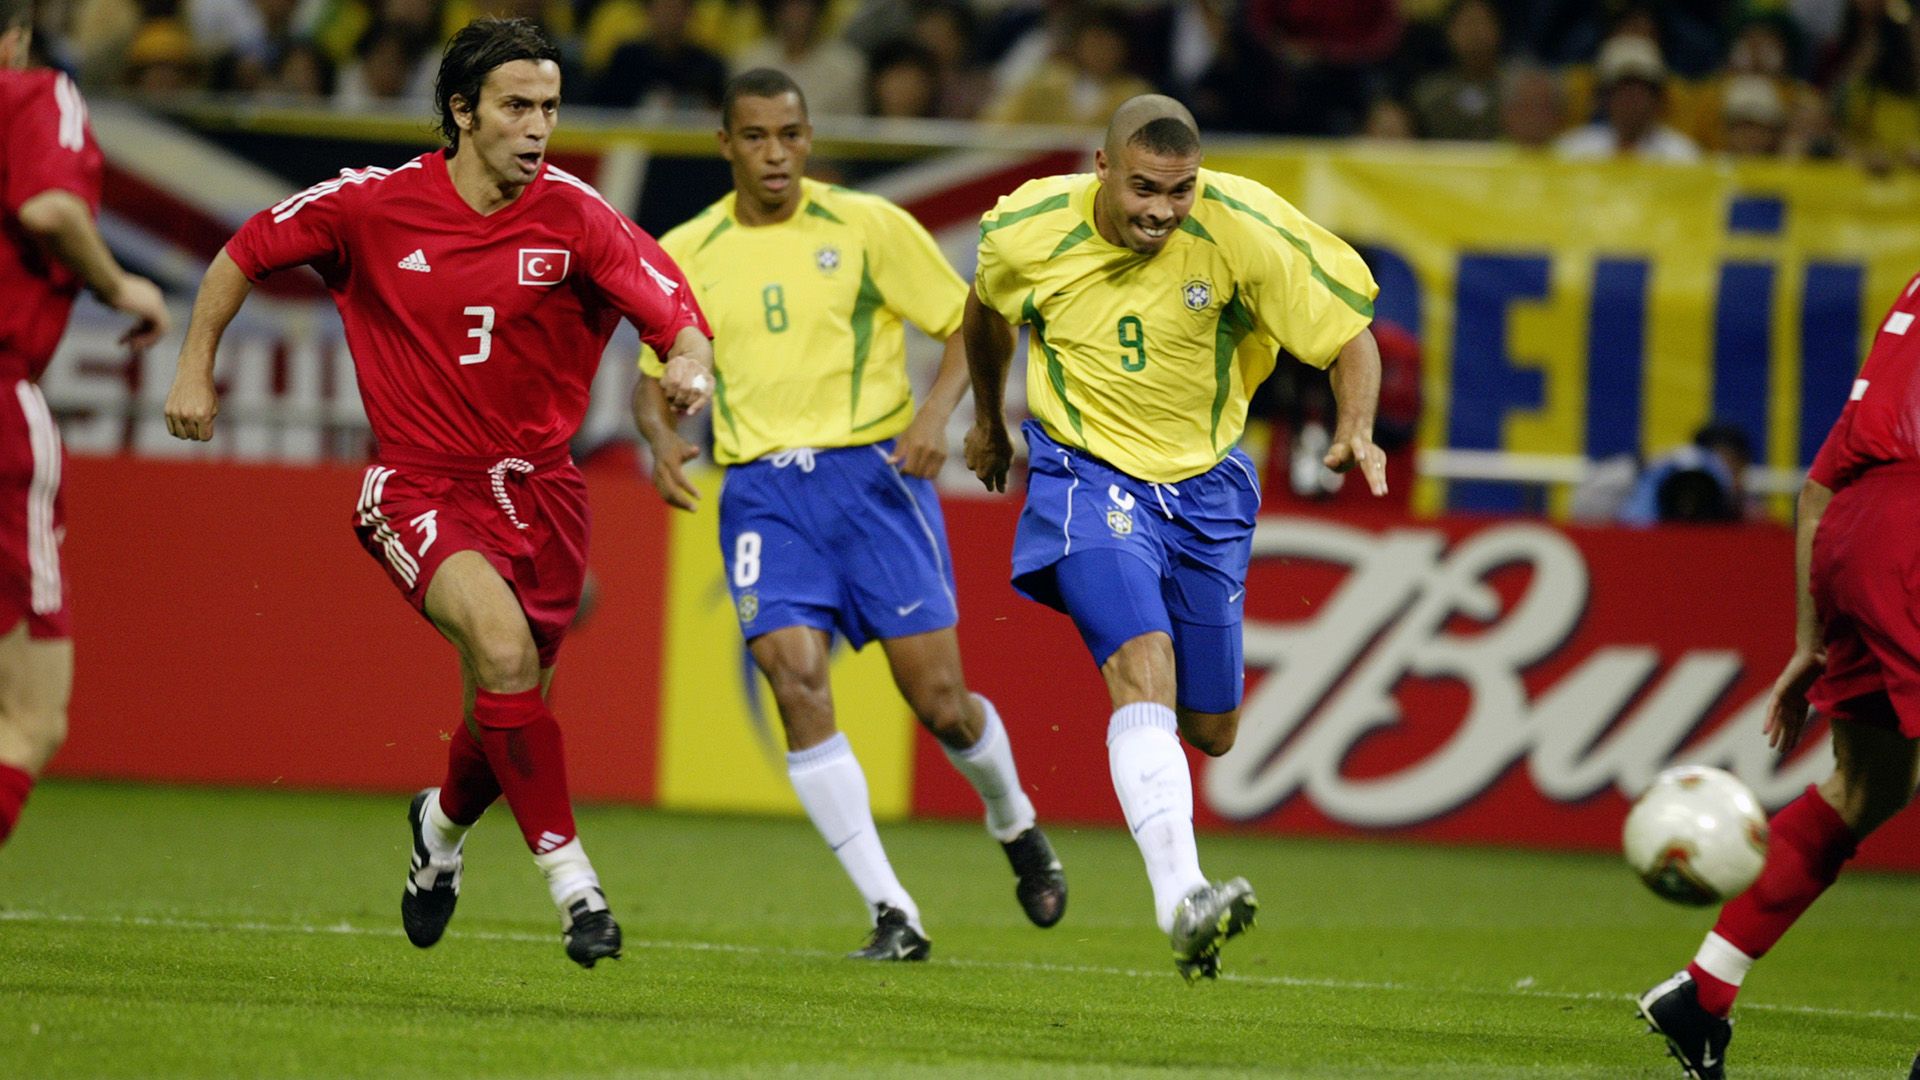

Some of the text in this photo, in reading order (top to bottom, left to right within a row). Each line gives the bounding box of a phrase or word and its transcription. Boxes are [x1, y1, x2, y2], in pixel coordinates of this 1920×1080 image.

[459, 305, 495, 365] 3
[763, 284, 788, 333] 8
[1117, 315, 1146, 372] 9
[410, 509, 438, 557] 3
[734, 531, 761, 587] 8
